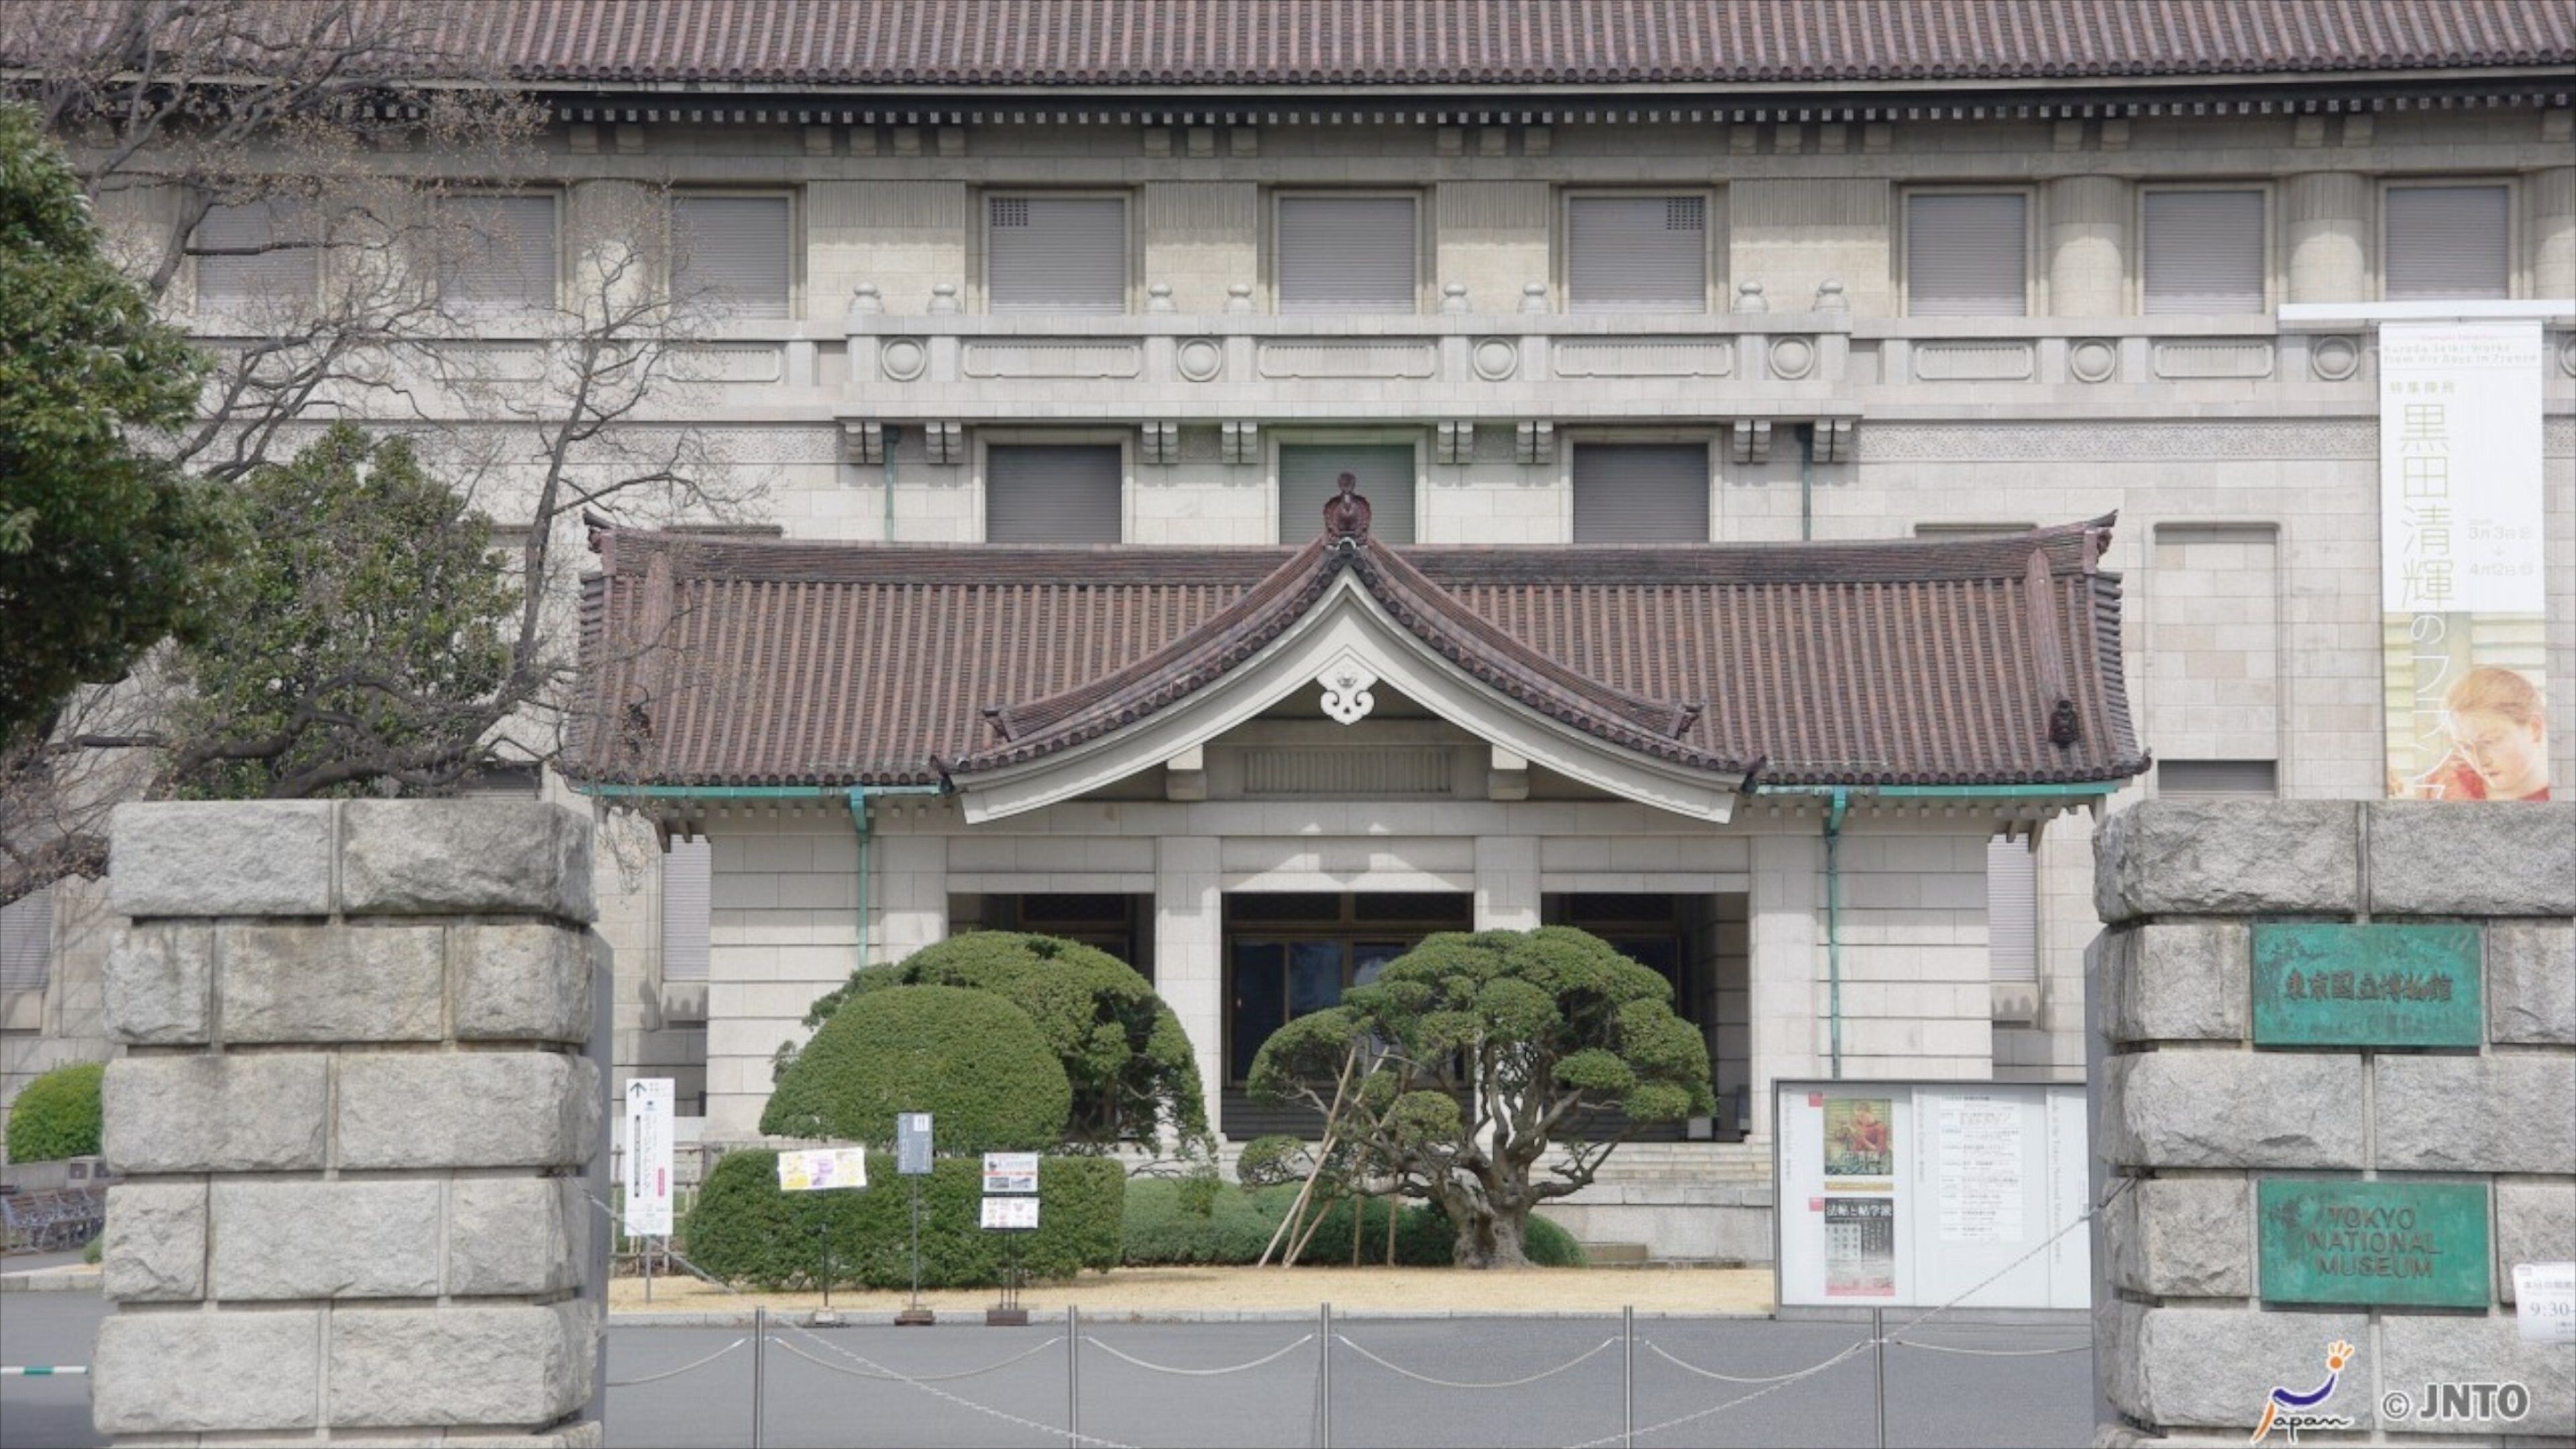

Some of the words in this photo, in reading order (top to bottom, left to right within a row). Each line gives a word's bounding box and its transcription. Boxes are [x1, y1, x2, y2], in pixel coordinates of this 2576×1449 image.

[2328, 1206, 2416, 1230] TOKYO
[2306, 1230, 2443, 1254] NATIONAL
[2316, 1254, 2434, 1279] MUSEUM
